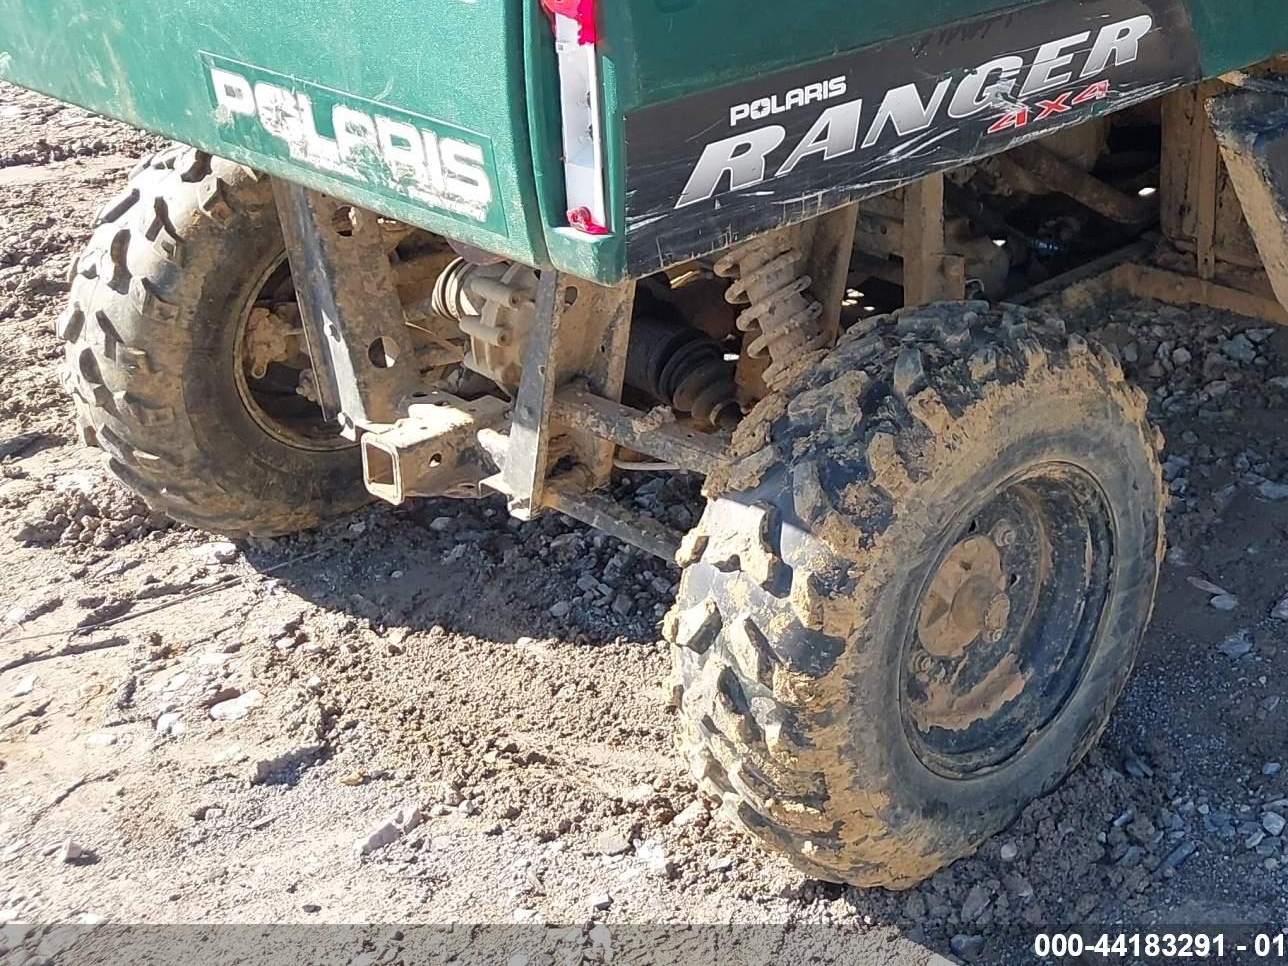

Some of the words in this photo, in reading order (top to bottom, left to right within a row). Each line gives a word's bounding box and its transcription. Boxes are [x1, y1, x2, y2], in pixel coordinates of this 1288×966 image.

[210, 67, 492, 223] POLARIS
[674, 14, 1153, 210] RANGER
[729, 75, 848, 127] POLARIS
